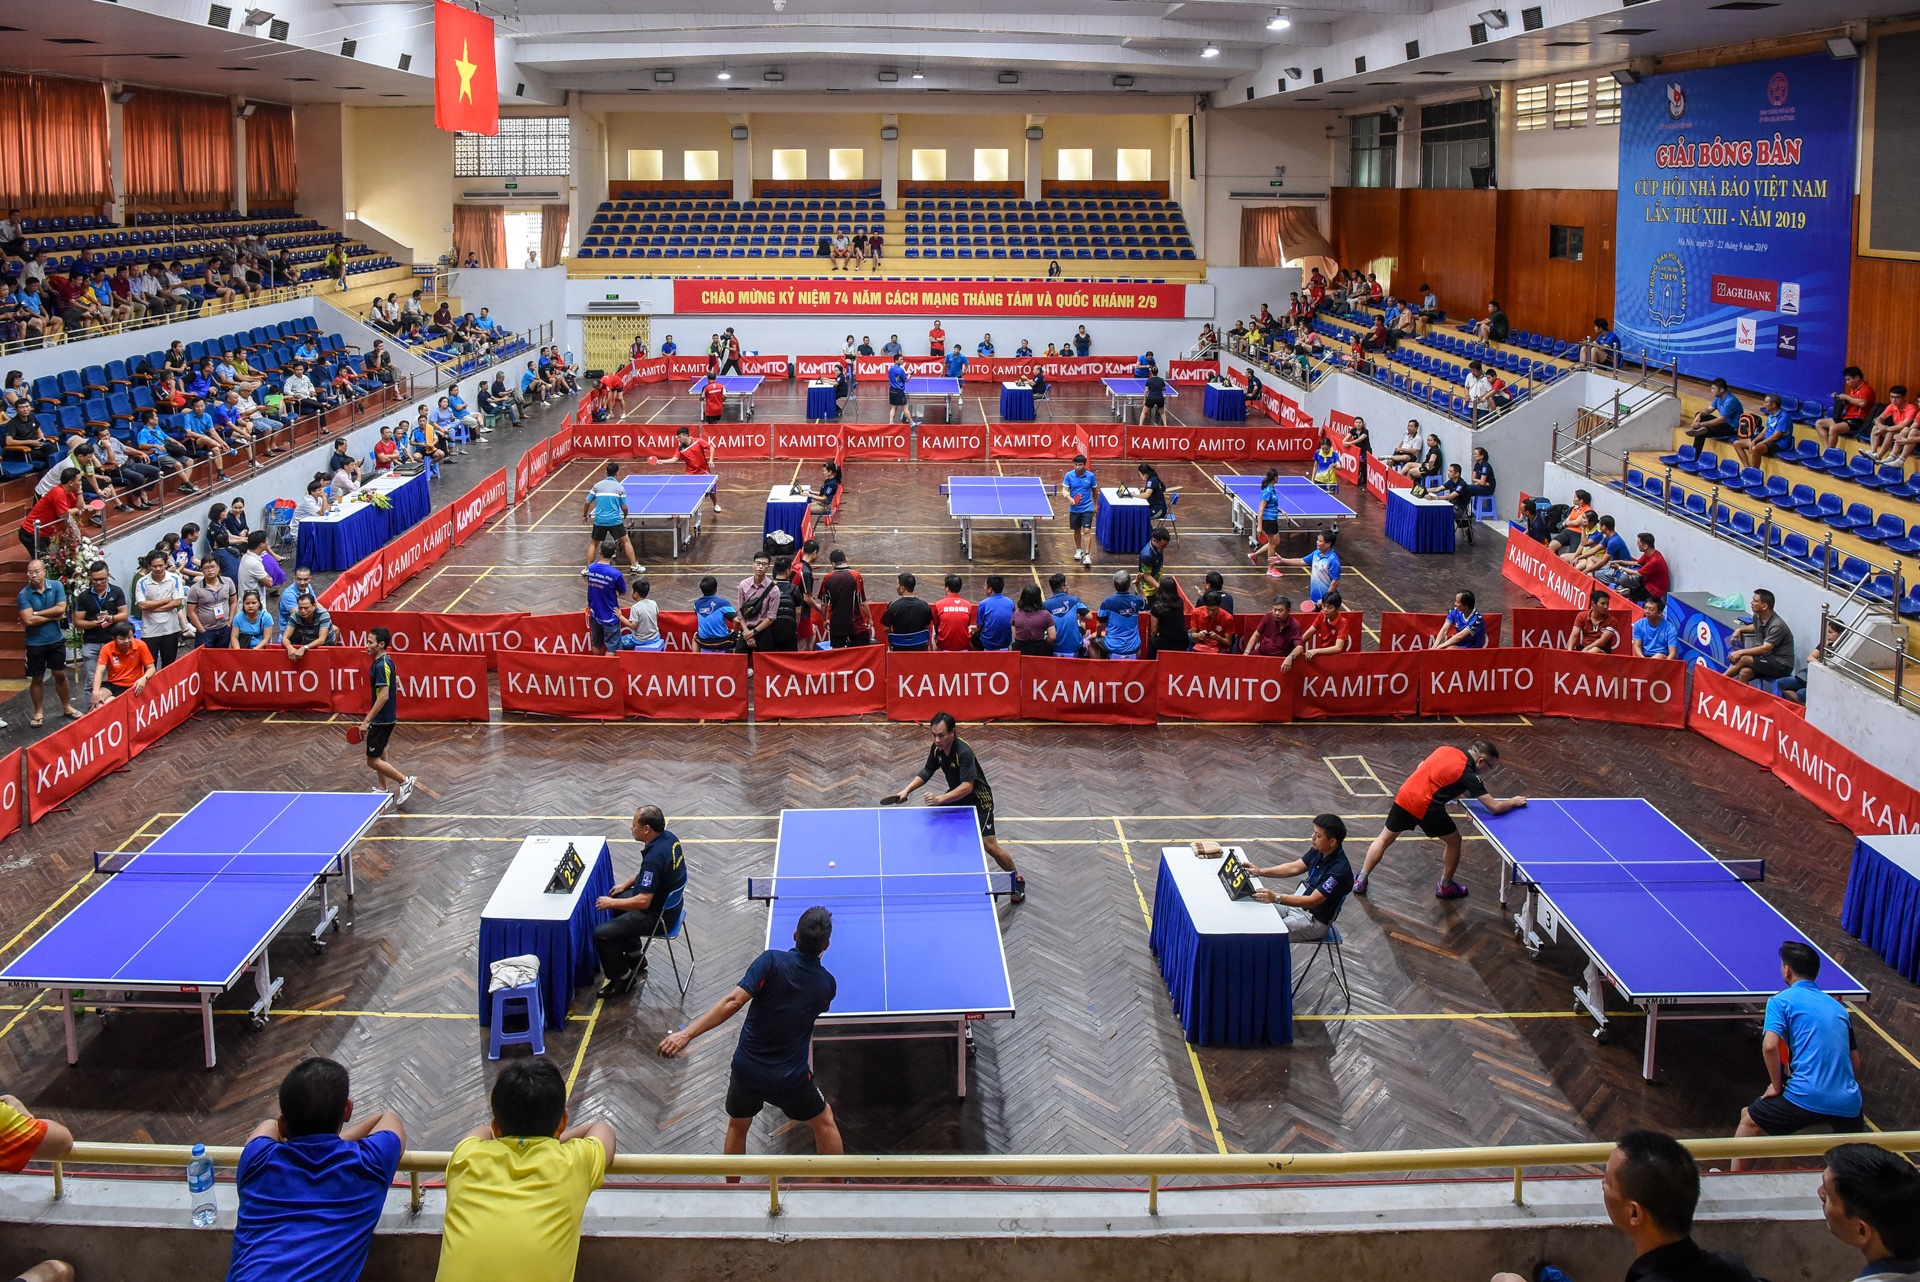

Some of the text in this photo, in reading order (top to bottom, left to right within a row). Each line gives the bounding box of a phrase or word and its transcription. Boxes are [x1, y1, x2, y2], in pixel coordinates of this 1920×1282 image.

[1656, 132, 1802, 168] GIẢI BÓNG BÀN
[1634, 174, 1828, 201] CÚP HỘI NHÀ BÁO VIỆT NAM
[1645, 199, 1670, 222] LẦN
[1674, 203, 1700, 224] THỨ
[1703, 208, 1727, 225] XIII
[1739, 204, 1772, 227] NĂM
[1775, 211, 1806, 228] 2019
[1707, 240, 1714, 248] 20
[1717, 240, 1724, 249] 22
[1739, 242, 1743, 250] 9
[1755, 243, 1768, 252] 2019
[1660, 273, 1677, 281] 2019
[701, 286, 1157, 309] CHÀO MỪNG KỶ NIỆM 74 NĂM CÁCH MẠNG THÁNG TÁM VÀ QUỐC KHÁNH 2/9
[1726, 287, 1772, 302] AGRIBANK
[635, 365, 666, 378] KAMITO
[742, 362, 787, 374] KAMITO
[1060, 363, 1103, 376] KAMITO
[573, 435, 632, 448] KAMITO
[638, 436, 678, 448] KAMI
[708, 434, 765, 448] KAMITO
[780, 435, 837, 447] KAMITO
[847, 435, 905, 448] KAMITO
[922, 436, 980, 449] KAMITO
[994, 435, 1051, 447] KAMITO
[1132, 437, 1190, 450] KAMITO
[1198, 438, 1245, 450] AMITO
[1256, 438, 1313, 450] KAMITO
[456, 481, 506, 532] KAMITO KAMITO
[388, 520, 452, 581] KAMITO KAMITO
[1547, 570, 1586, 610] KAMITO
[422, 630, 522, 652] KAMITO
[1700, 626, 1707, 641] 2
[214, 670, 319, 692] KAMITO
[395, 675, 476, 699] AMITO
[508, 672, 614, 698] KAMITO
[628, 674, 736, 698] KAMITO
[766, 668, 875, 698] KAMITO
[899, 672, 1010, 698] KAMITO
[1033, 679, 1145, 704] KAMITO
[1168, 674, 1281, 702] KAMITO
[1302, 673, 1409, 698] KAMITO
[1431, 668, 1534, 695] KAMITO
[1554, 672, 1671, 703] KAMITO
[135, 672, 201, 732] KAMITO
[1697, 692, 1773, 741] KAMIT
[36, 721, 123, 794] KAMITO
[1778, 730, 1851, 801] KAMITO
[565, 870, 574, 886] 2
[1225, 858, 1235, 873] 5
[1232, 874, 1244, 888] 5
[1545, 910, 1551, 929] 3
